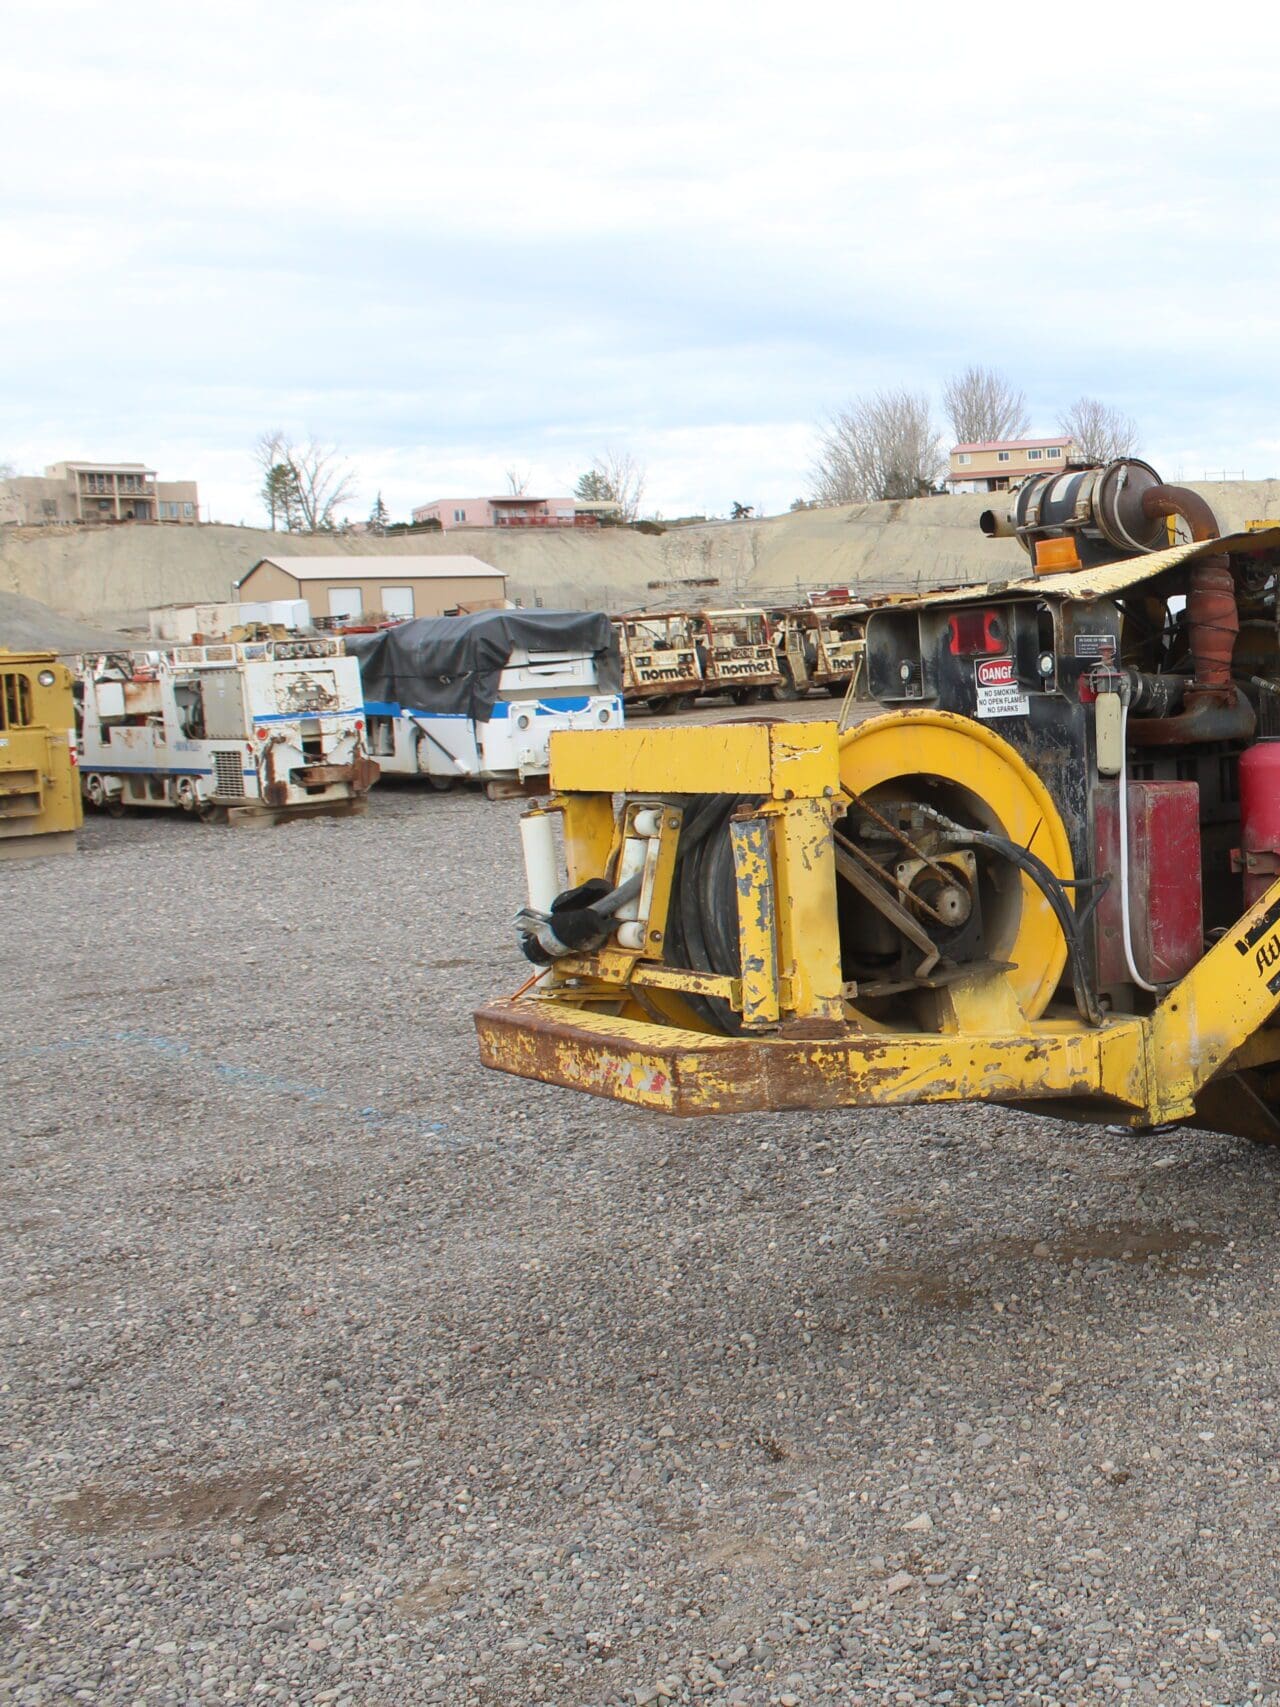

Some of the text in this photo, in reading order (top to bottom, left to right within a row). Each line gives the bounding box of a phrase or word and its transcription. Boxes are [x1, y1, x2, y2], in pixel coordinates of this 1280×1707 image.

[721, 661, 770, 674] normet
[832, 659, 853, 668] nor
[641, 665, 693, 680] normet
[982, 666, 1012, 680] DANGE
